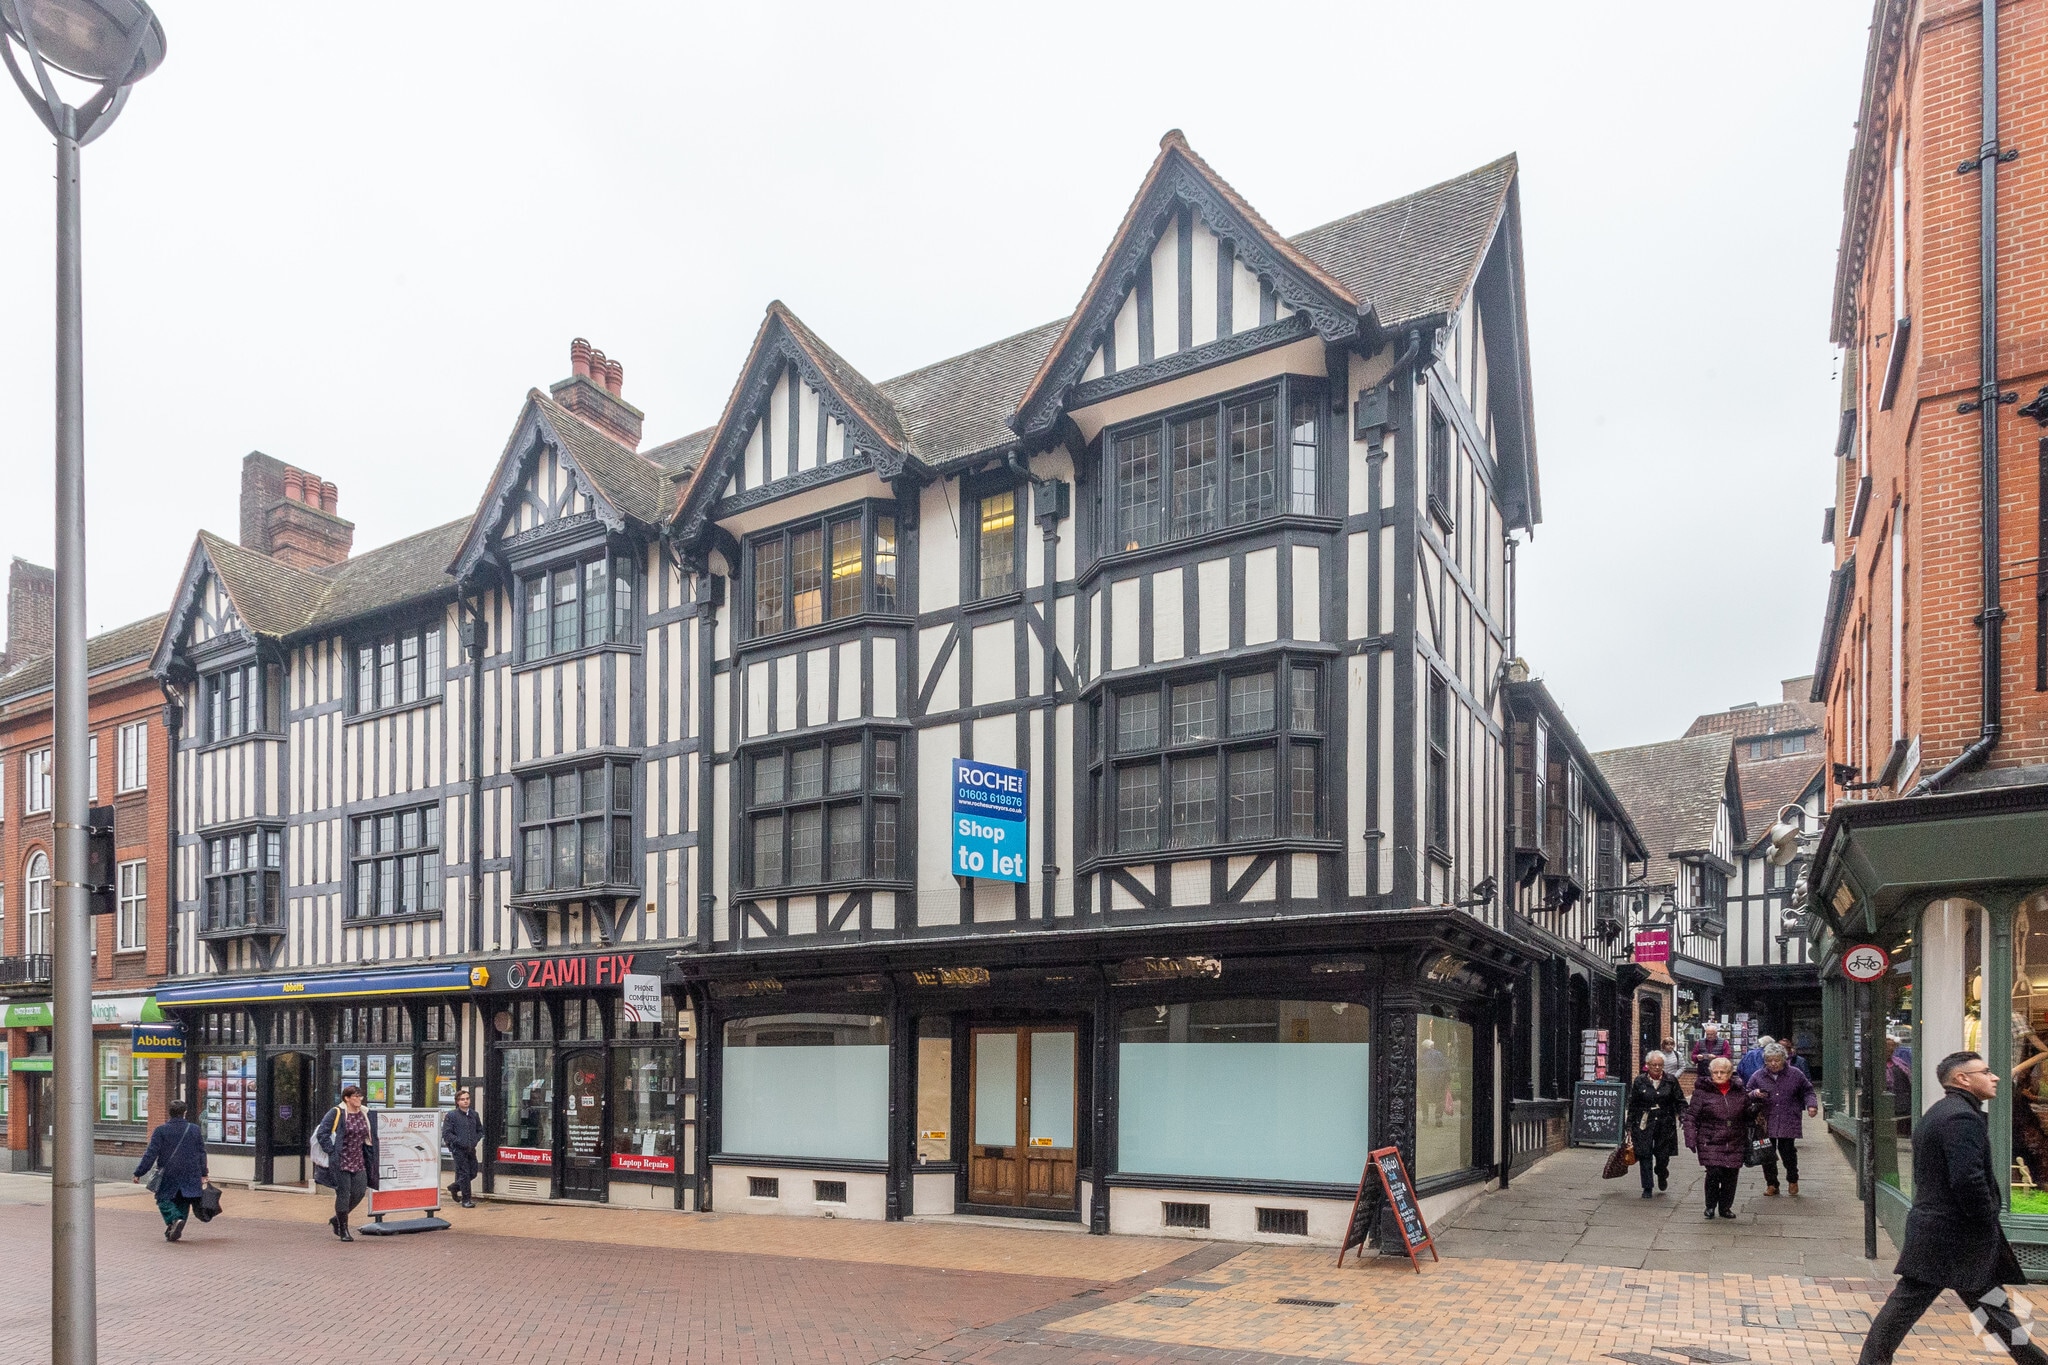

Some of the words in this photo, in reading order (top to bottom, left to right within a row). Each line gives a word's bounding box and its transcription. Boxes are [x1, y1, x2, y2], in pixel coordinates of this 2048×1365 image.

[958, 766, 1018, 793] ROCHE
[959, 788, 988, 801] 01603
[990, 793, 1022, 807] 619876
[958, 799, 1022, 814] www.rochesurveyors.co.uk
[958, 819, 1005, 844] Shop
[958, 845, 984, 872] to
[992, 849, 1023, 877] let
[527, 957, 586, 988] ZAMI
[595, 955, 635, 985] FIX
[282, 982, 305, 993] Abbotts
[629, 994, 660, 1002] COMPUTER
[137, 1035, 182, 1047] Abbotts
[1585, 1097, 1611, 1107] OPEN
[500, 1150, 516, 1160] Water
[517, 1151, 541, 1162] Damage
[542, 1153, 552, 1162] Fix
[619, 1157, 641, 1168] Laptop
[643, 1158, 669, 1169] Repairs
